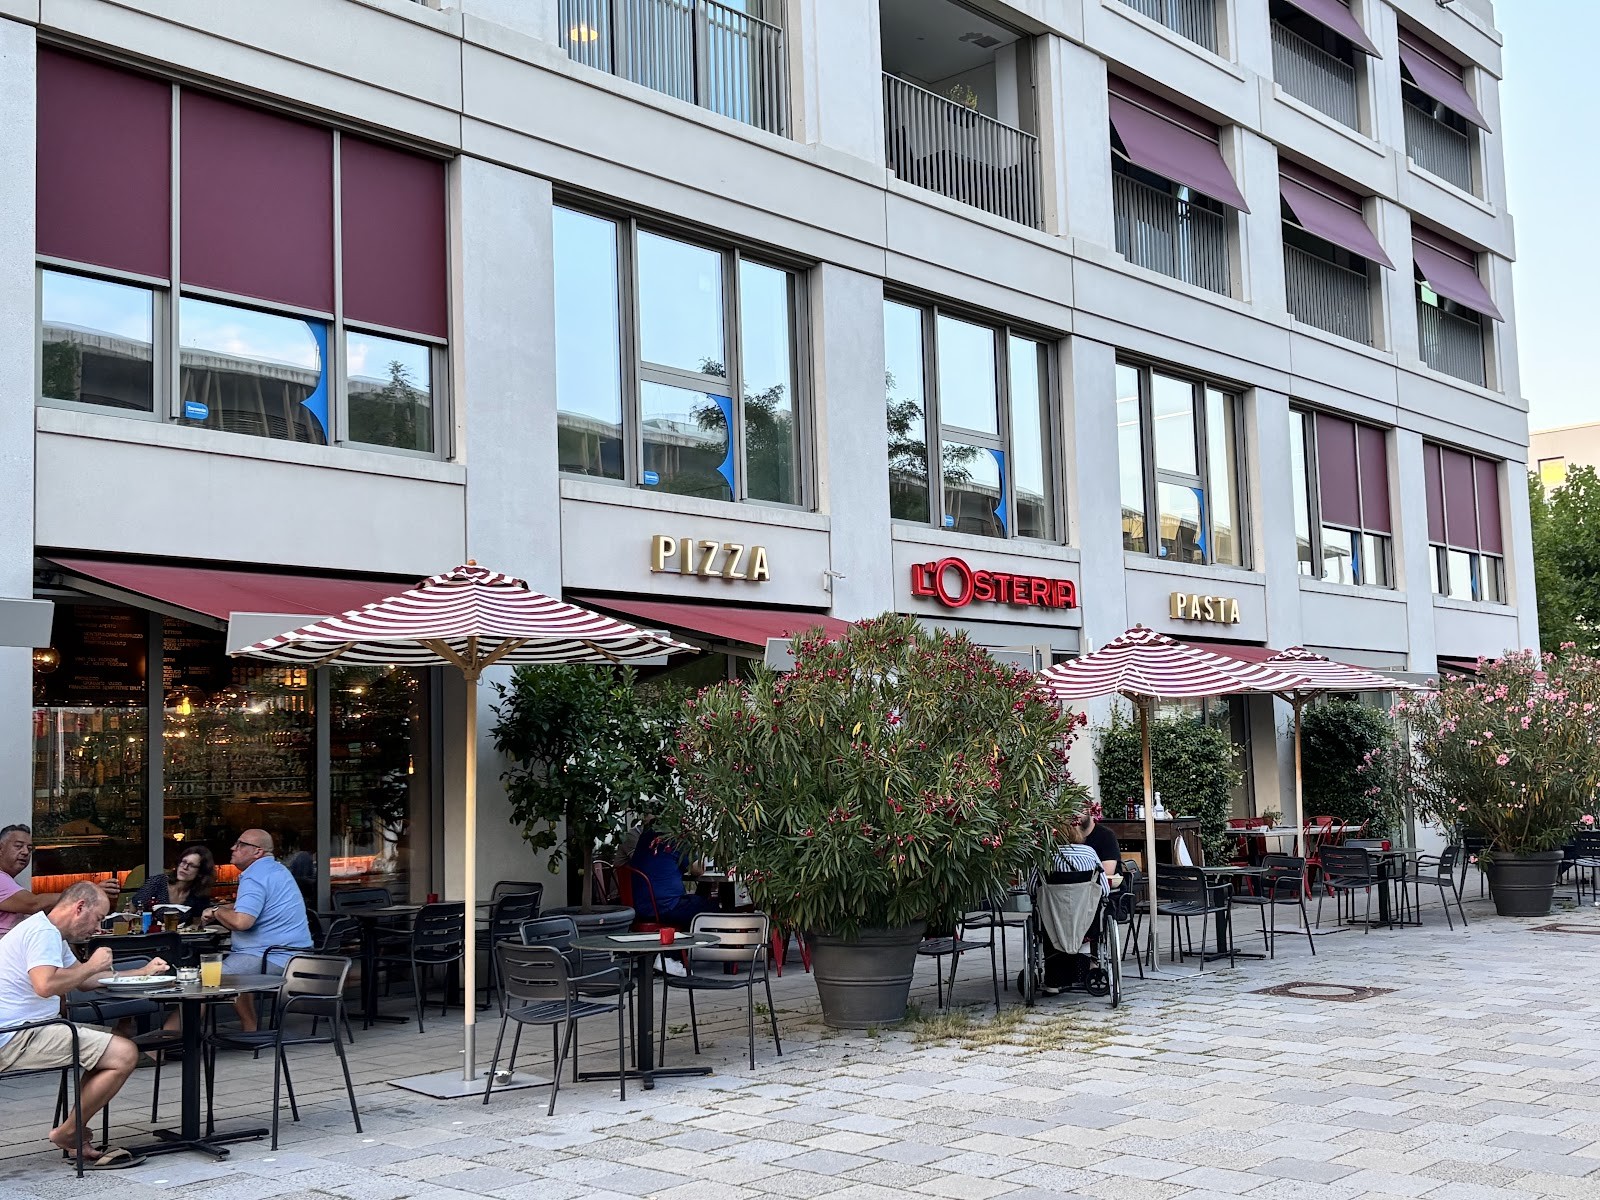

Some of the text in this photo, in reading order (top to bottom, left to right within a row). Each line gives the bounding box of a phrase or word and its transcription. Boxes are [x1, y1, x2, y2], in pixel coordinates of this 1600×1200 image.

[650, 535, 770, 581] PIZZA
[911, 557, 1077, 609] L'OSTERIA
[1170, 592, 1240, 624] PASTA
